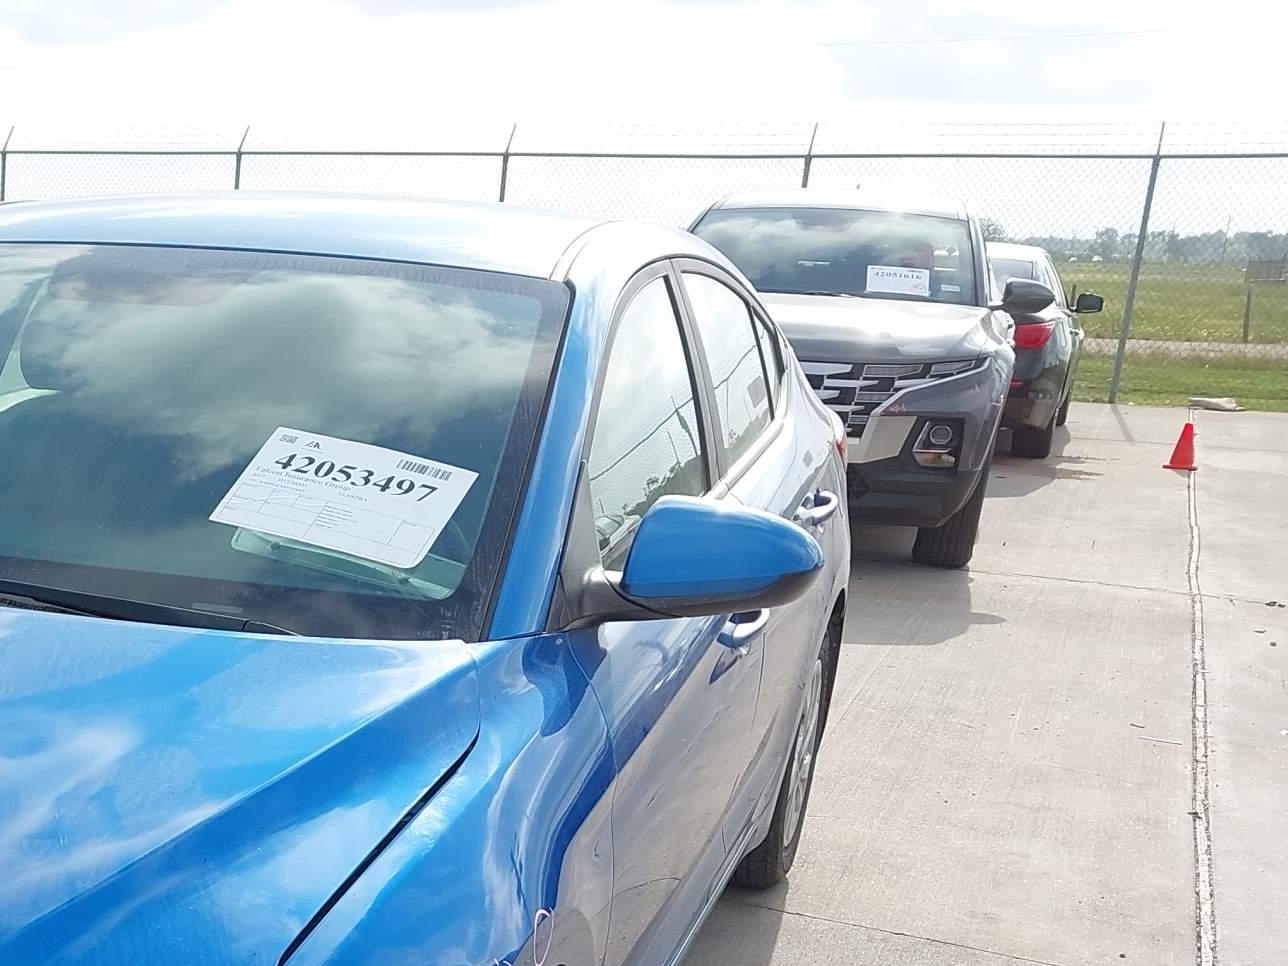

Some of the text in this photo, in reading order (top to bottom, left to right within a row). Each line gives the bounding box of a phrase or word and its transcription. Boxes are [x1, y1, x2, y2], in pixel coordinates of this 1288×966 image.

[256, 465, 283, 477] Falcon
[284, 471, 324, 486] Insurance
[324, 481, 352, 493] Group
[274, 453, 439, 502] 42053497
